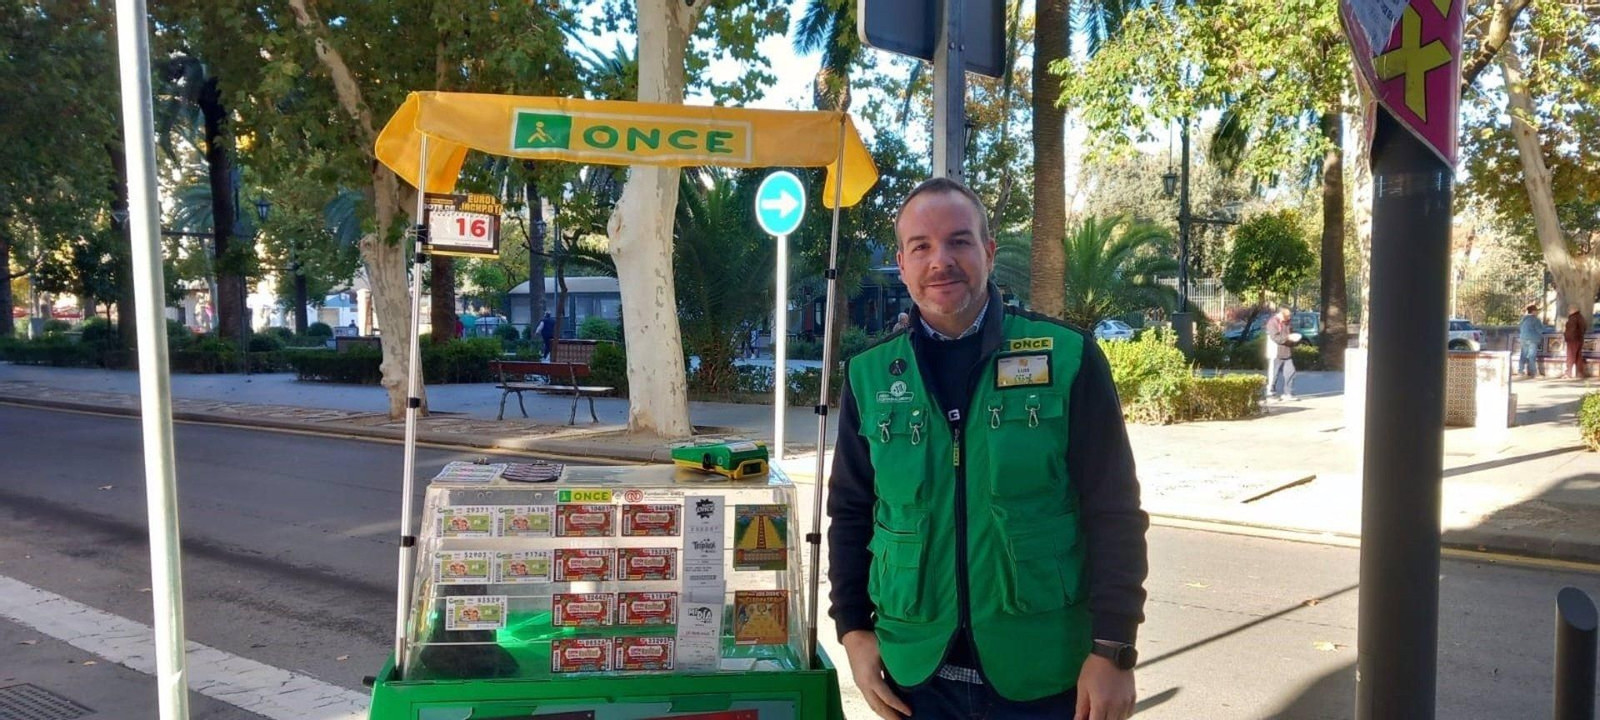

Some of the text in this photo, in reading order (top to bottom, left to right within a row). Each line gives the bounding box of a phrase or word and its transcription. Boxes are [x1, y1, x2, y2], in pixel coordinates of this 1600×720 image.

[583, 125, 733, 153] ONCE
[456, 218, 486, 237] 16
[1013, 340, 1049, 349] ONCE
[574, 491, 609, 500] ONCE
